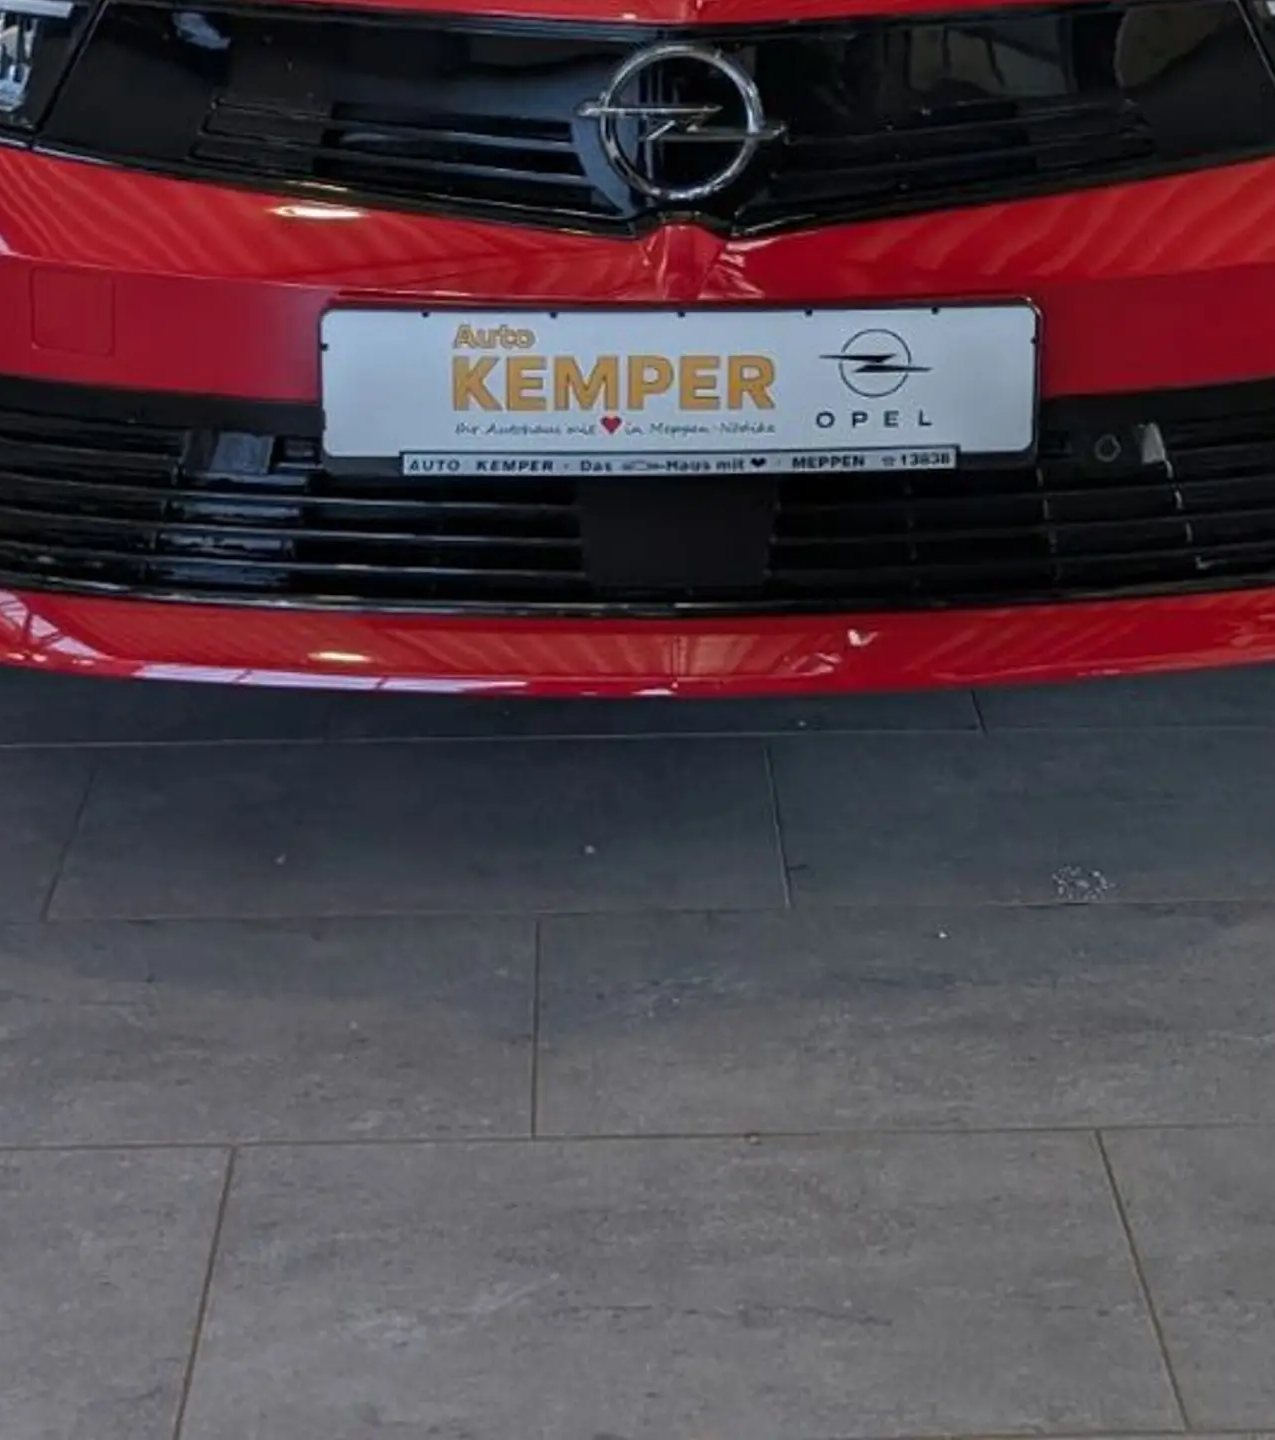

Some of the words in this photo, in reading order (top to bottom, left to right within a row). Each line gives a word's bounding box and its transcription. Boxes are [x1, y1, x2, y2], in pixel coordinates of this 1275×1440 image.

[453, 323, 536, 349] Auto
[452, 355, 775, 411] KEMPER
[816, 409, 934, 428] OPEL
[409, 460, 461, 472] AUTO
[476, 459, 554, 472] KEMPER
[580, 459, 613, 472] Das
[716, 458, 745, 471] mit
[792, 455, 866, 469] MEPPEN
